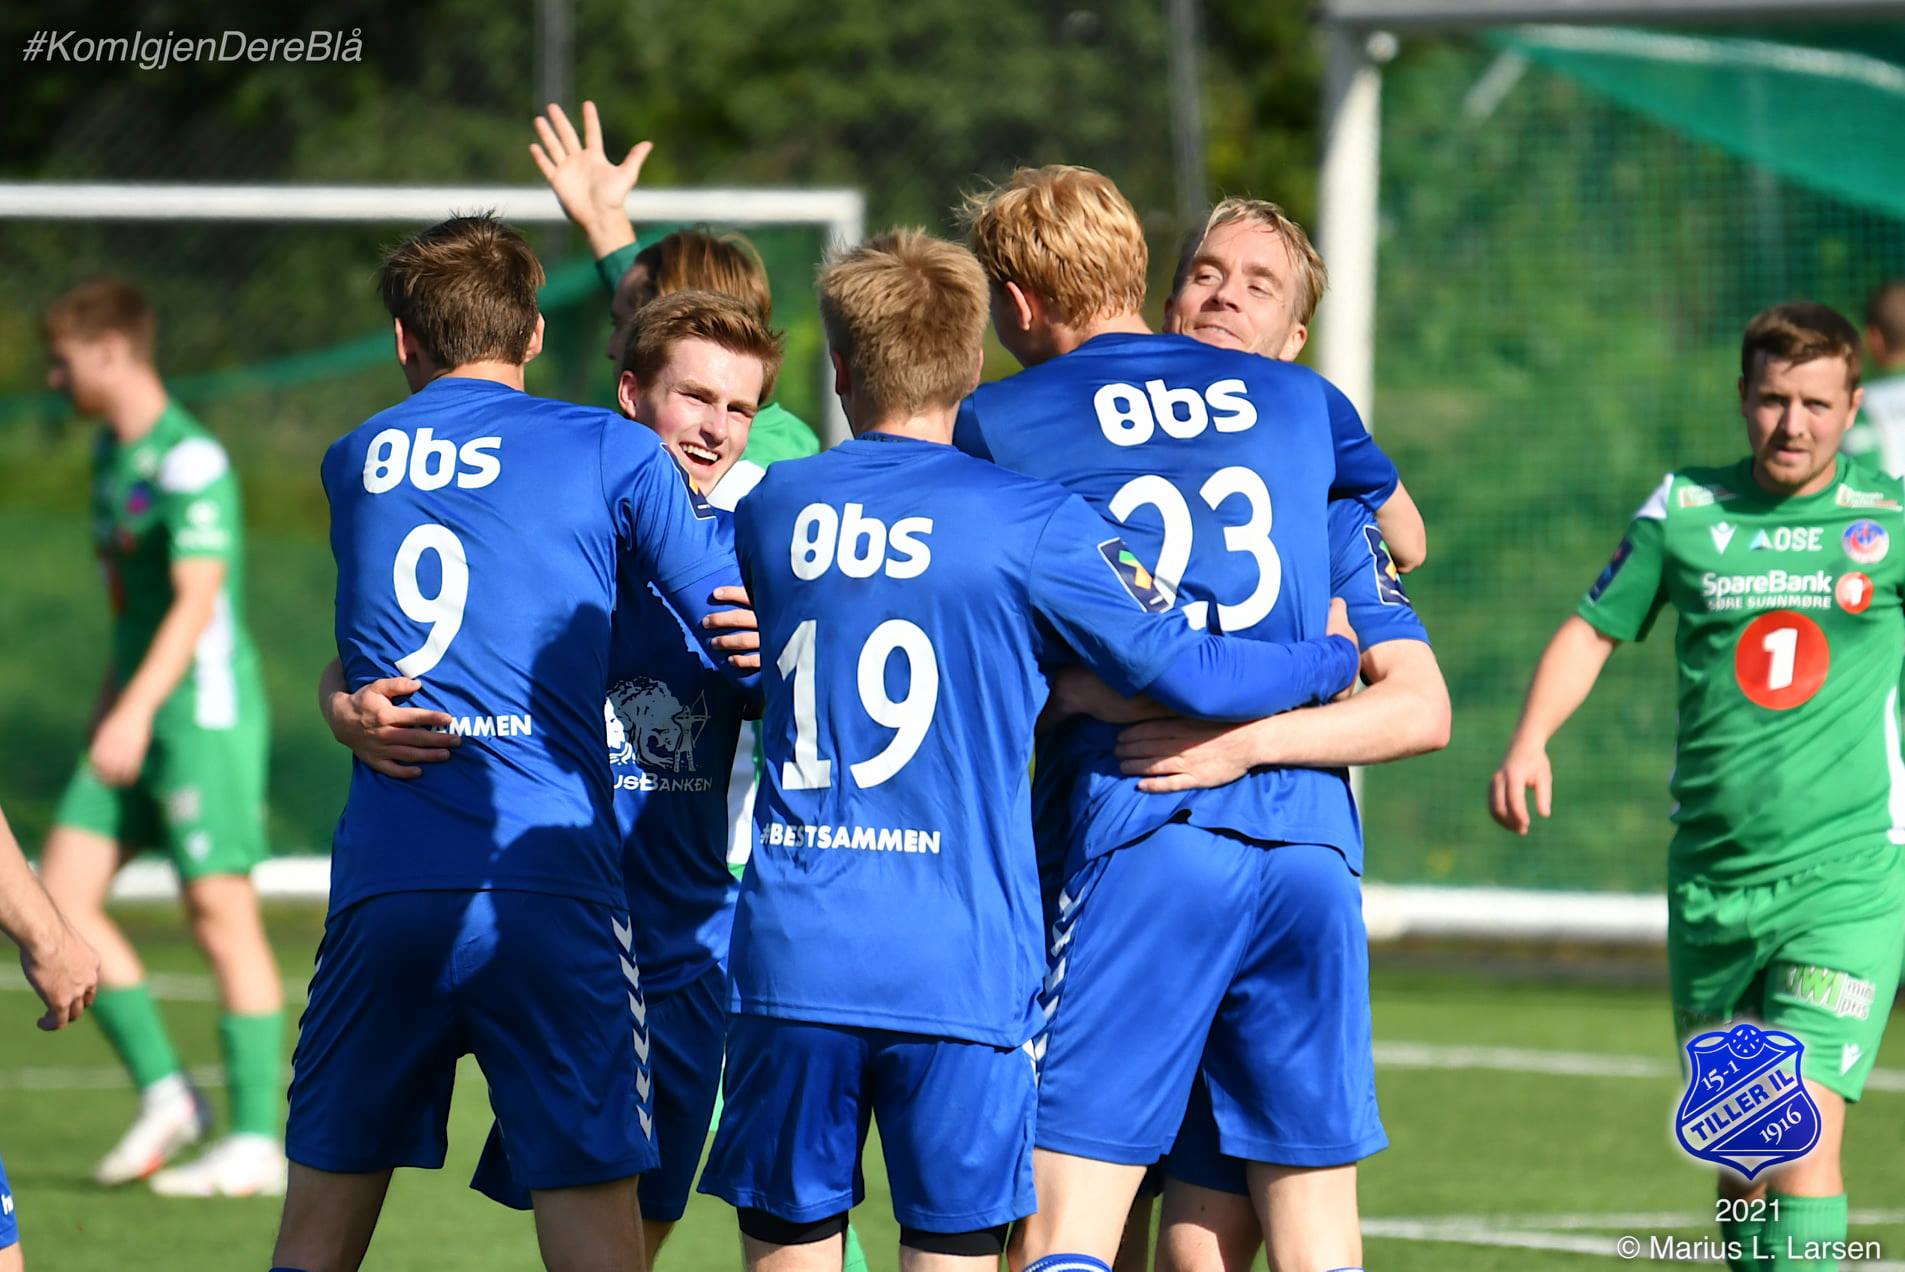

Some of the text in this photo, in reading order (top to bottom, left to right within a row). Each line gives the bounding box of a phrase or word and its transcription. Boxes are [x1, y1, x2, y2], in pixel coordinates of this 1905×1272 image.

[1109, 466, 1282, 631] 23
[393, 523, 470, 679] 9
[1702, 570, 1832, 602] SpareBank
[1747, 594, 1832, 609] SUNNMØRE
[1763, 627, 1798, 691] 1
[776, 618, 939, 790] 19
[760, 822, 941, 854] #BESTSAMMEN
